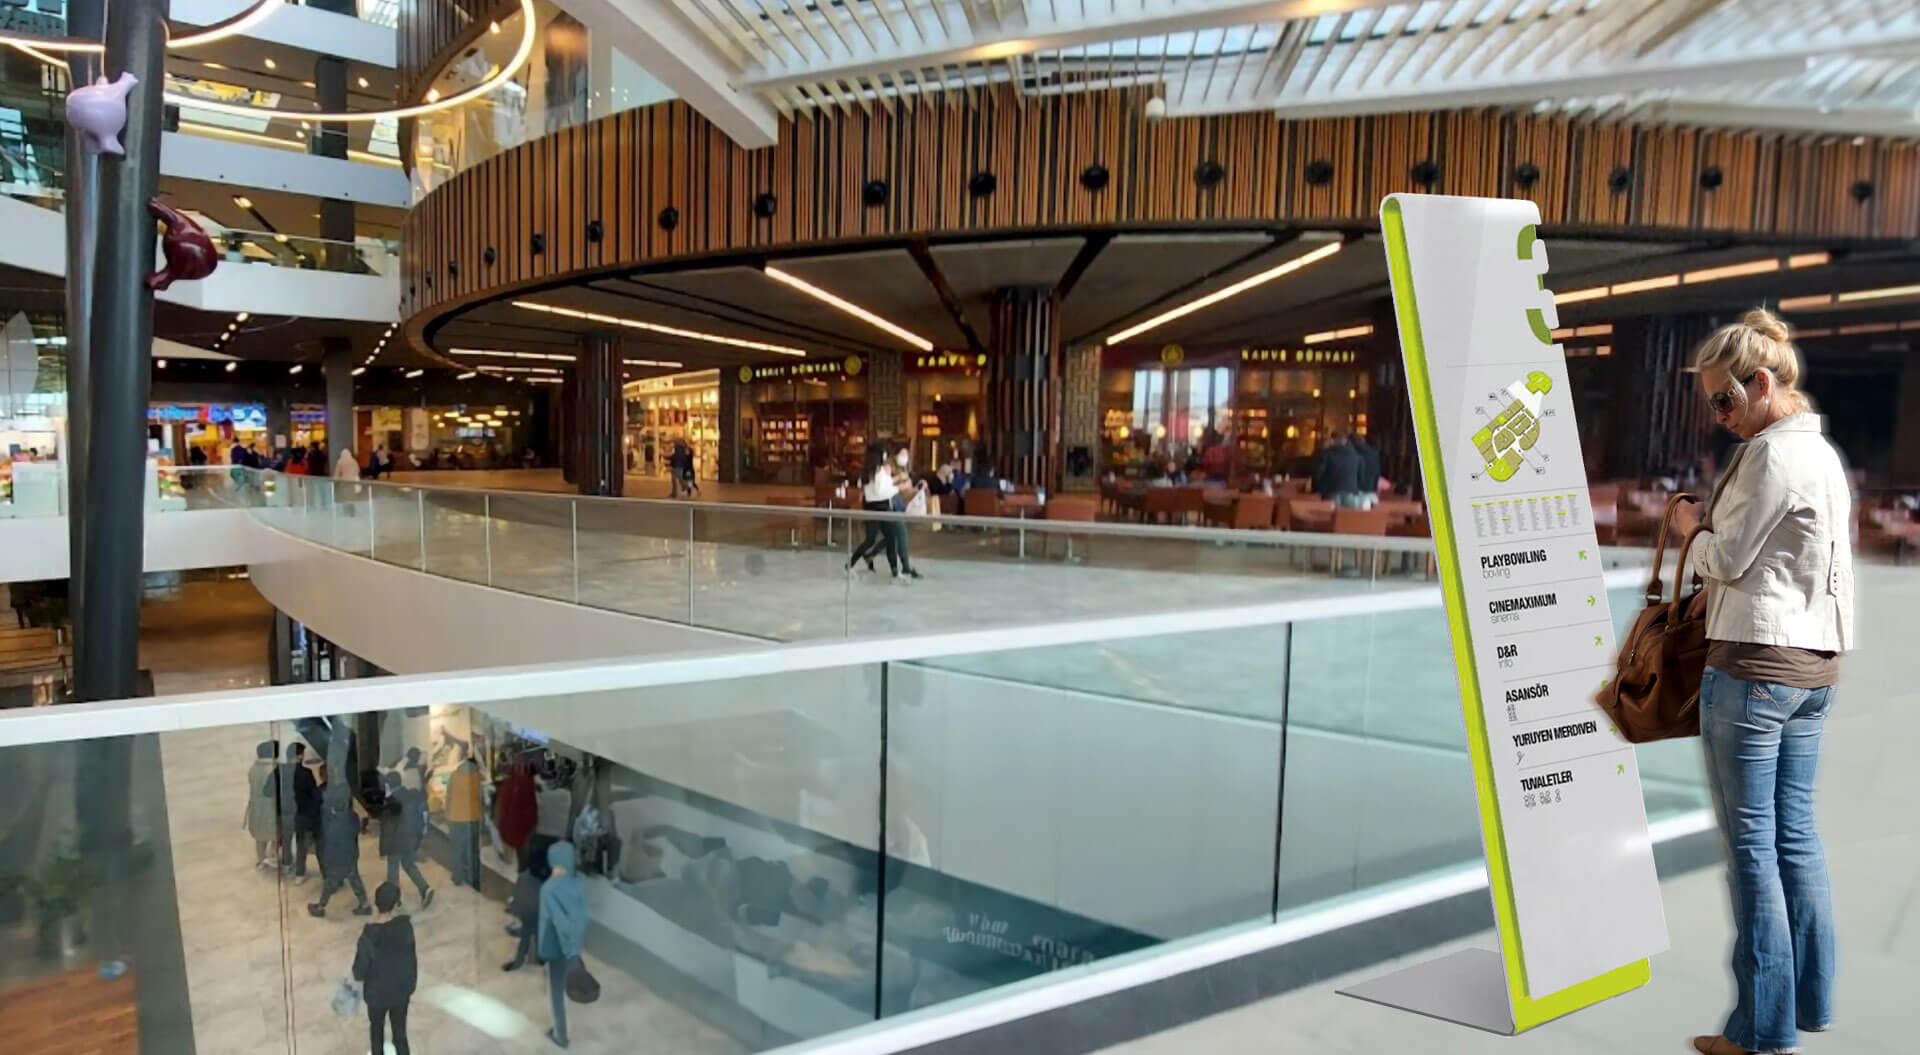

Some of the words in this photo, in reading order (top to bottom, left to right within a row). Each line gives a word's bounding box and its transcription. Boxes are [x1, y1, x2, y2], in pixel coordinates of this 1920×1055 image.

[1480, 549, 1547, 570] PLAYBOWLING
[1488, 593, 1557, 614] CINEMAXIMUM
[1496, 644, 1518, 660] D&R
[1505, 683, 1550, 704] ASANSÖR
[1512, 727, 1553, 748] YURUYEN
[1554, 720, 1598, 740] MERDIVEN
[1519, 770, 1574, 792] TUVALETLER
